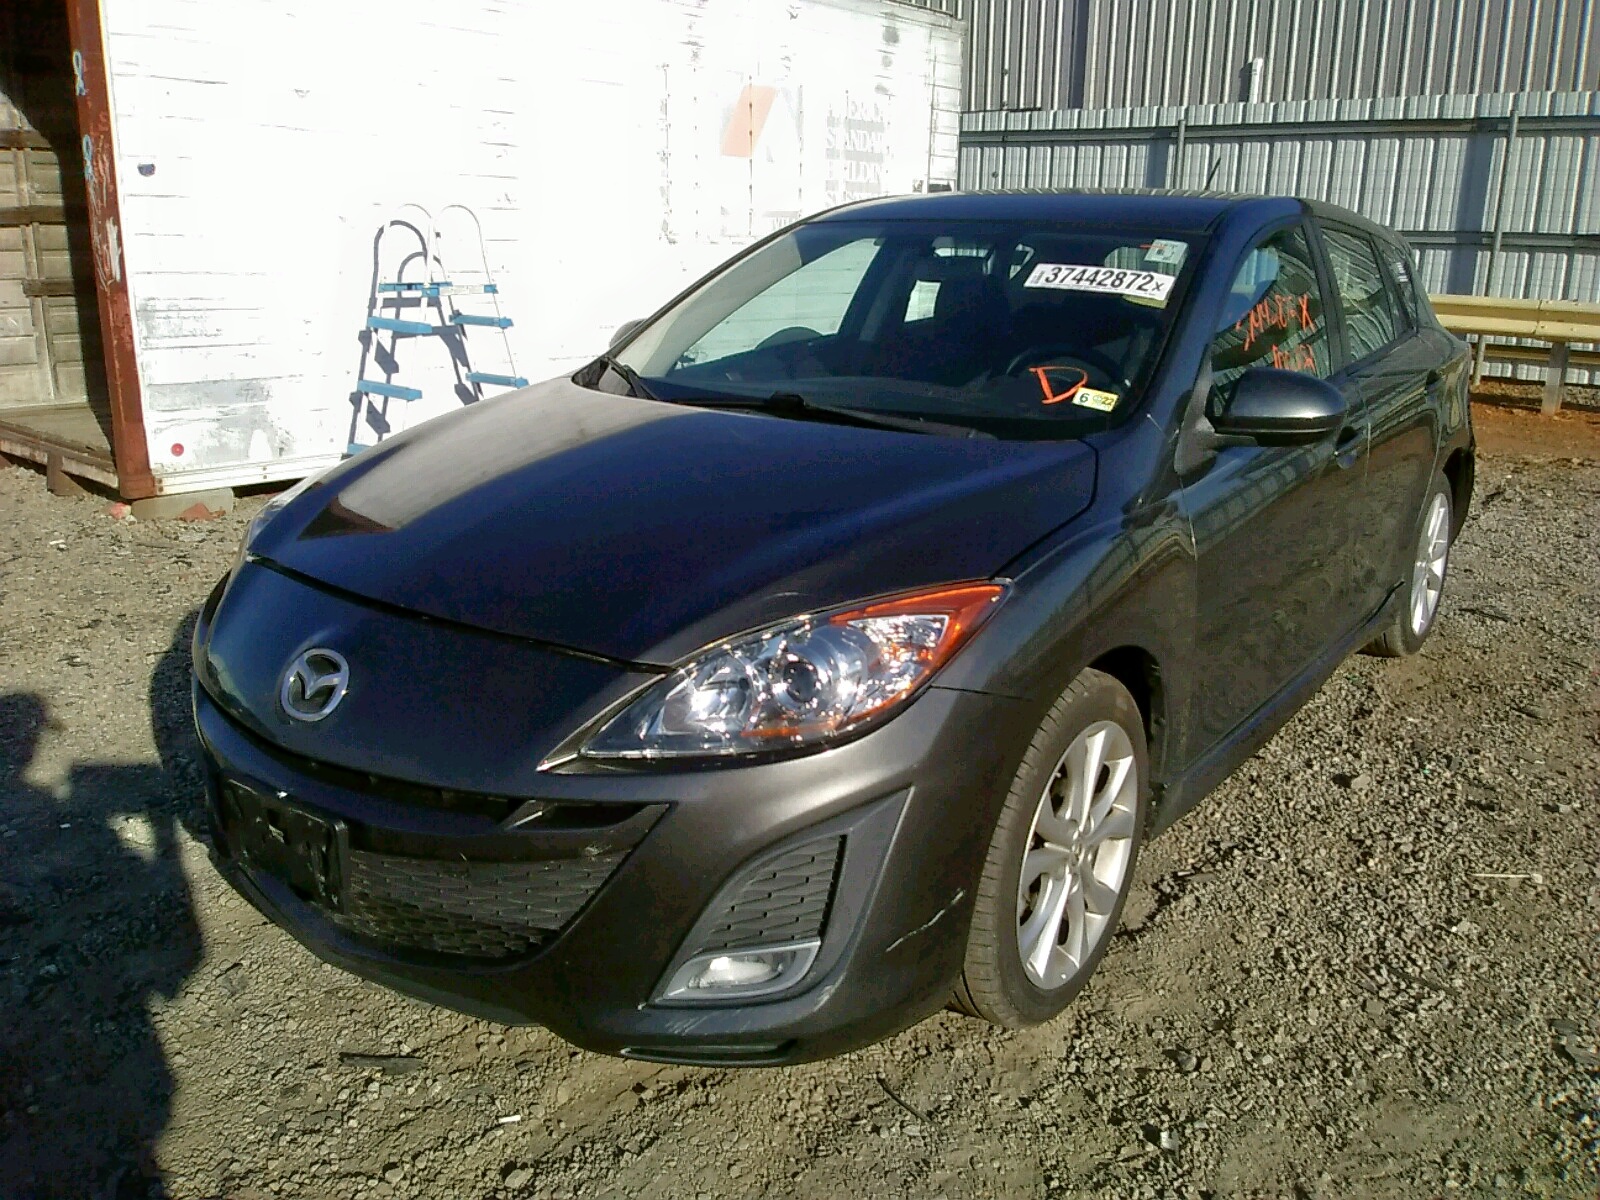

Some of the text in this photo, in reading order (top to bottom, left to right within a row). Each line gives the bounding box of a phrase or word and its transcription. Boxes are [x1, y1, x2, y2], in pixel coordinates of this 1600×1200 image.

[1029, 366, 1089, 405] D
[1079, 392, 1115, 406] 6 22
